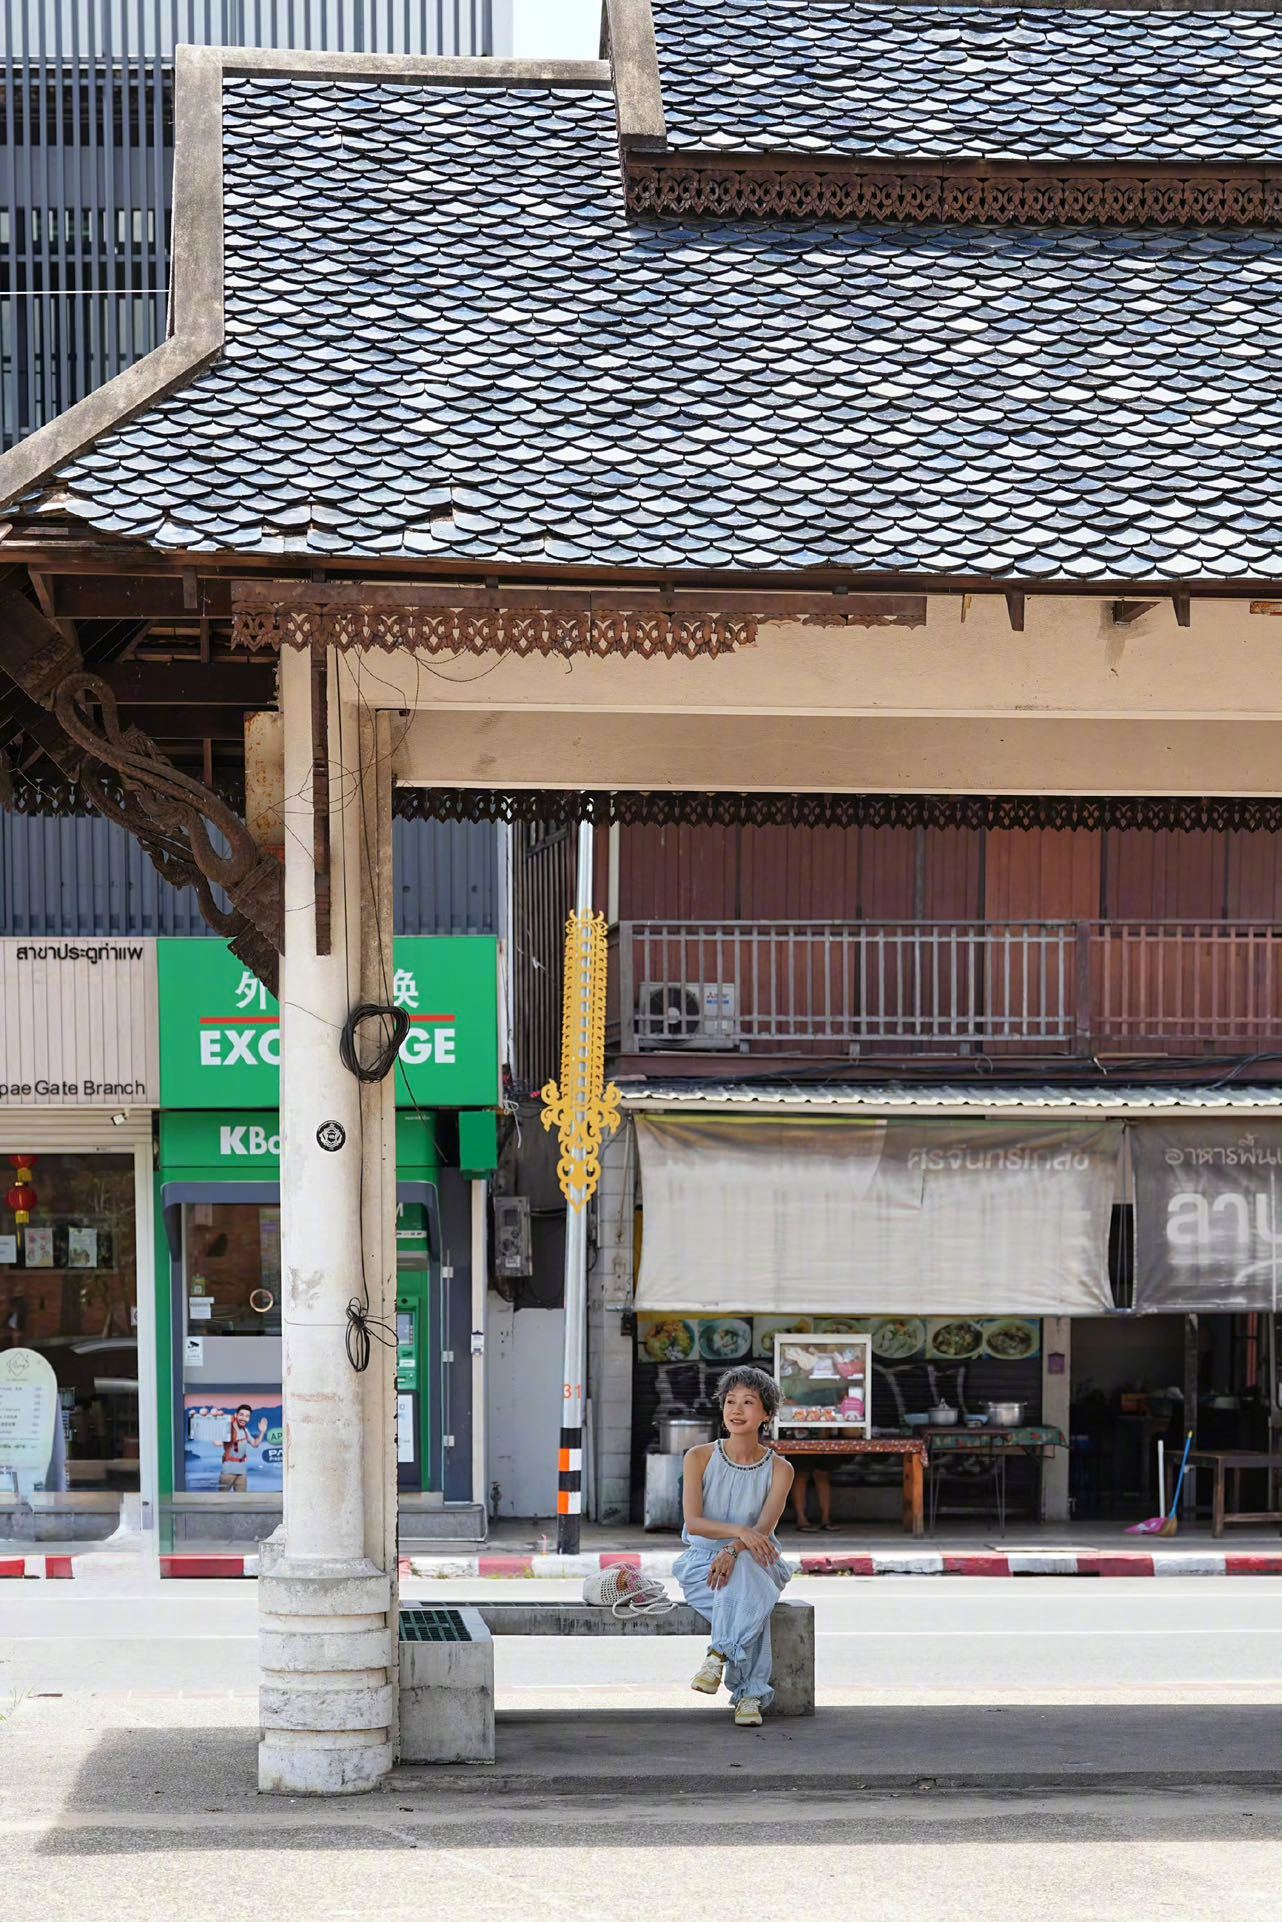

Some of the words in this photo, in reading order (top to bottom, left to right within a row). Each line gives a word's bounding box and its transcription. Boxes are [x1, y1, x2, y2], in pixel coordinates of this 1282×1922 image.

[16, 943, 143, 964] สาขาประตูท่าแพ
[34, 1079, 78, 1096] Gate
[83, 1079, 145, 1096] Branch
